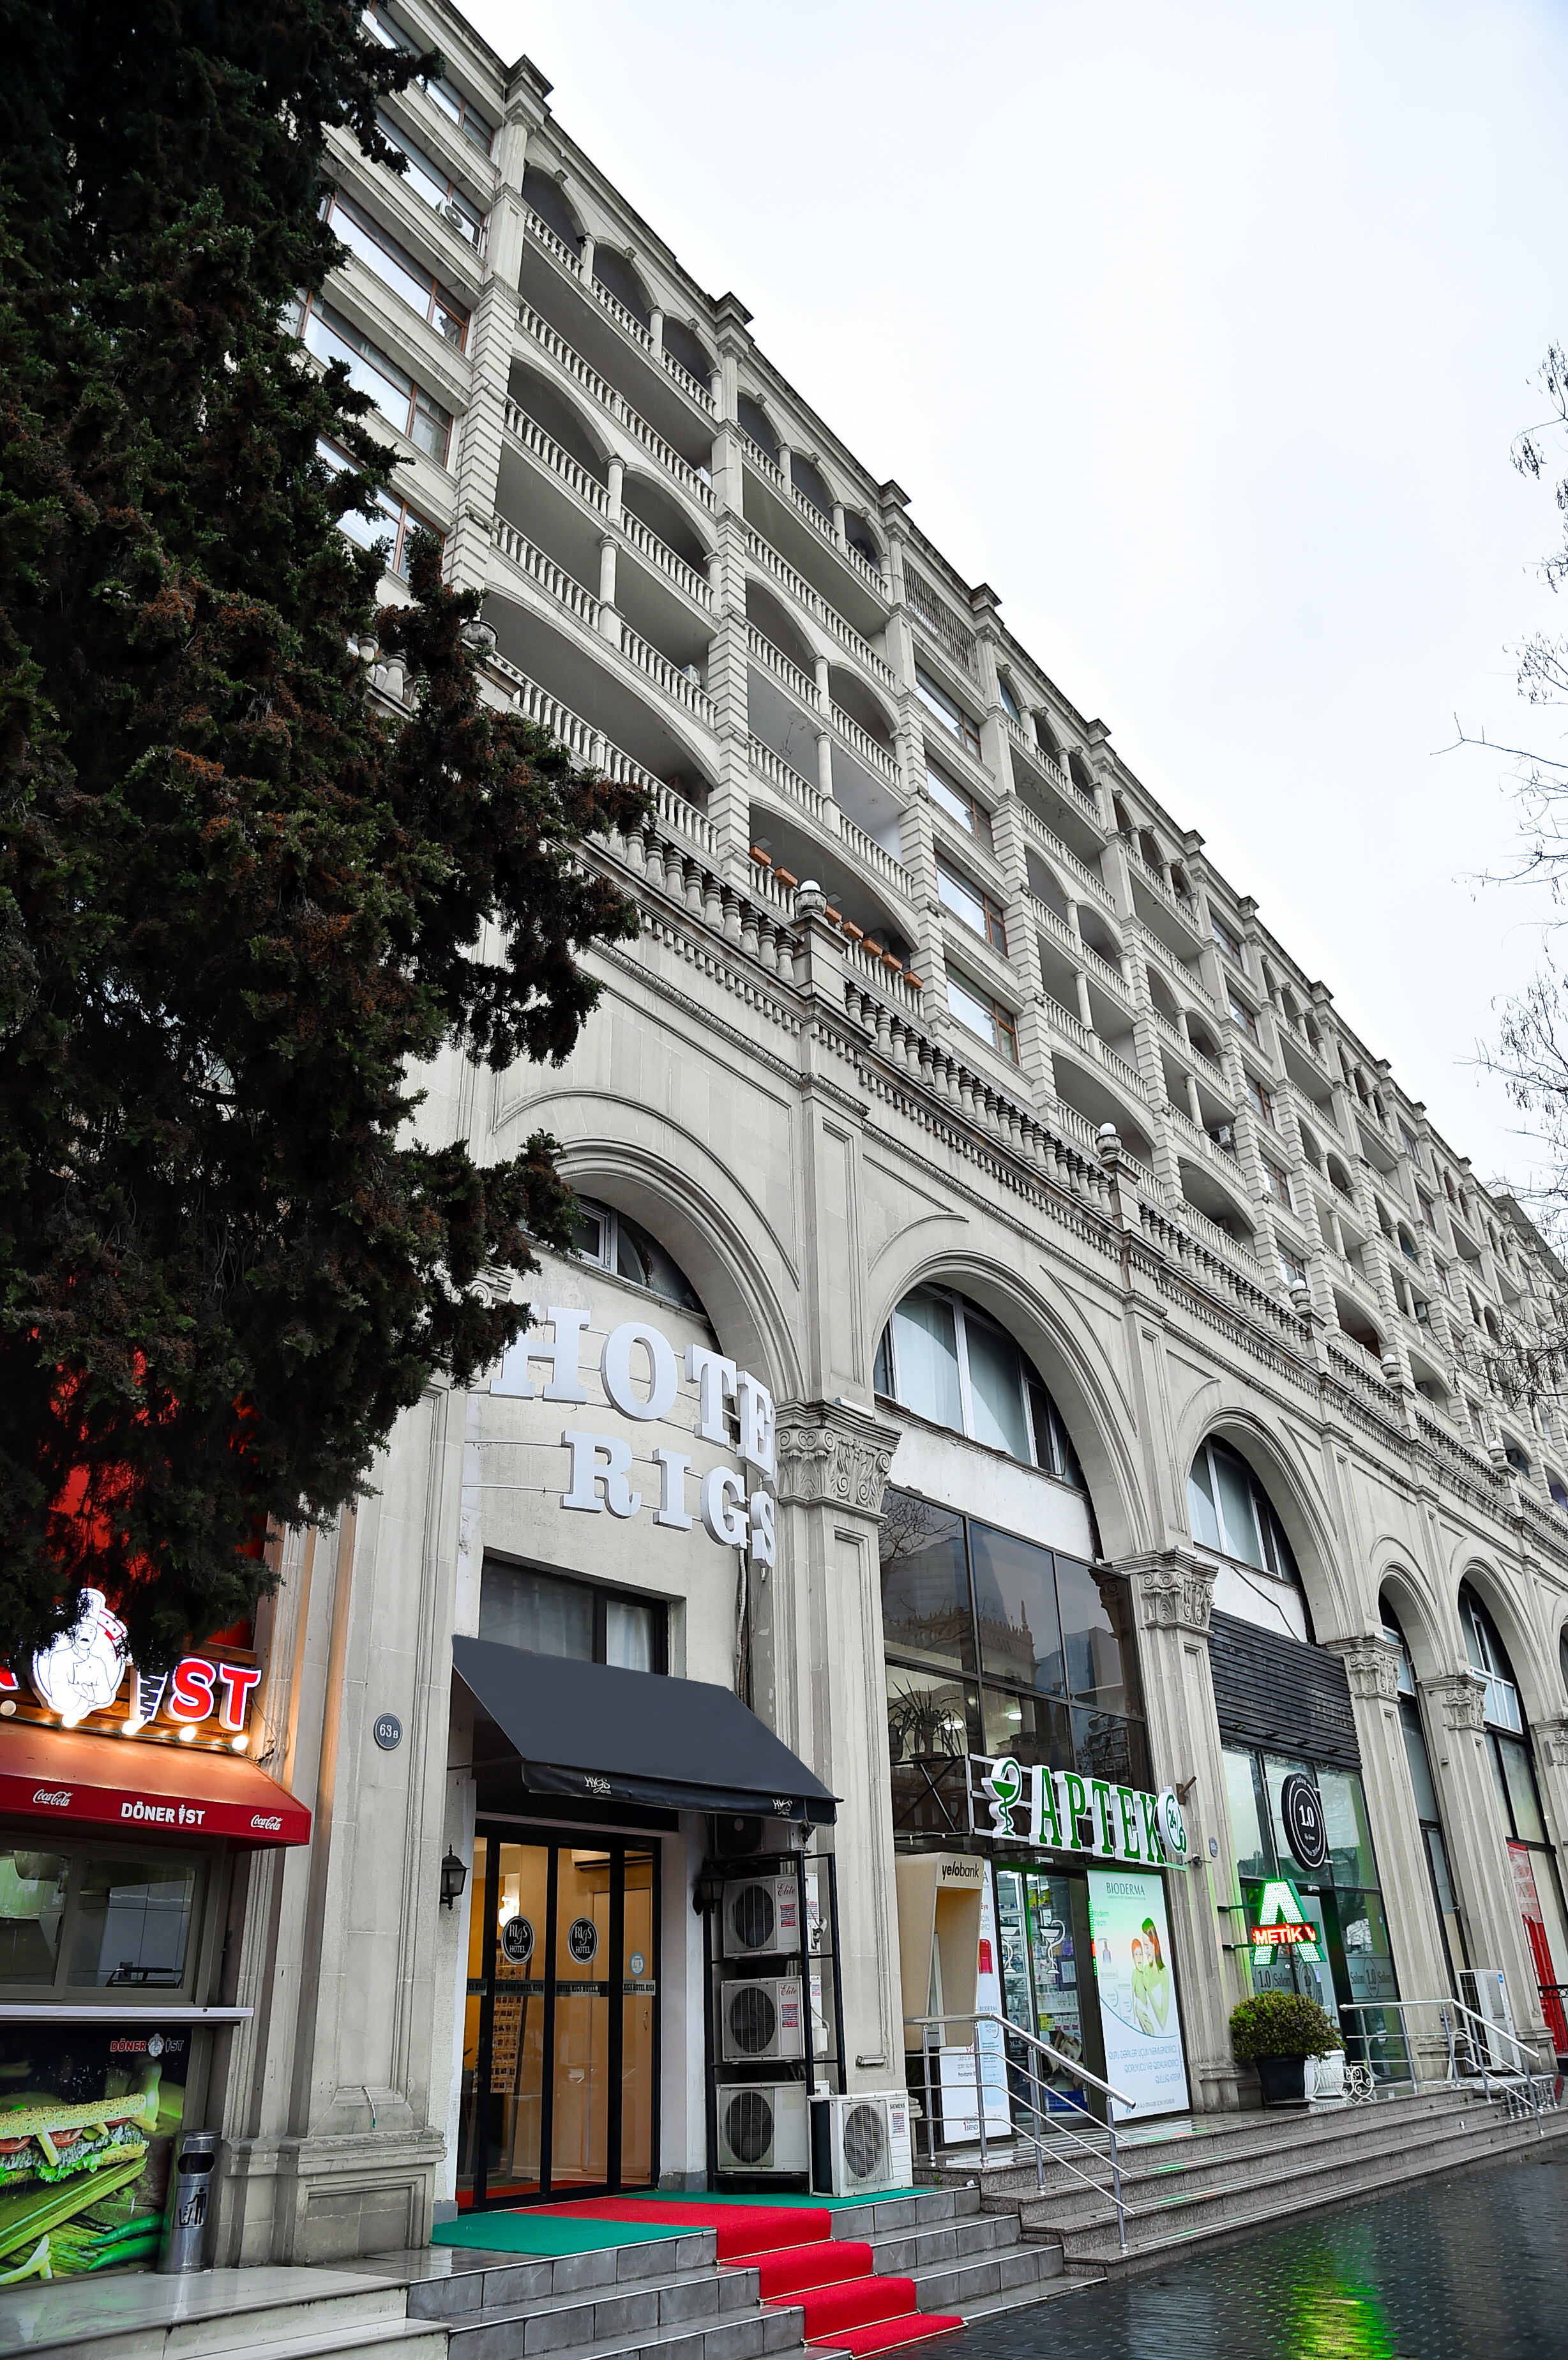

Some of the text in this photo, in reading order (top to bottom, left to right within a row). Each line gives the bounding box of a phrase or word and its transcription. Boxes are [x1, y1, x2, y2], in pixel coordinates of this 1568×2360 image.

[490, 1306, 776, 1498] HOTE
[560, 1429, 776, 1568] RIGS
[121, 1801, 175, 1824] DÖNER
[1029, 1764, 1165, 1867] APTEK
[942, 1861, 979, 1880] yelobank
[777, 1883, 796, 1896] Elite
[1106, 1882, 1145, 1896] BIODERMA
[1253, 1923, 1304, 1946] METİK
[509, 1945, 526, 1953] HOTEL
[575, 1946, 591, 1954] HOTEL
[1273, 1973, 1292, 1987] Salon
[1350, 1971, 1366, 1985] Salon
[1378, 1970, 1392, 1984] Salon
[780, 1984, 797, 1996] Elite
[110, 2038, 147, 2052] DÖNER
